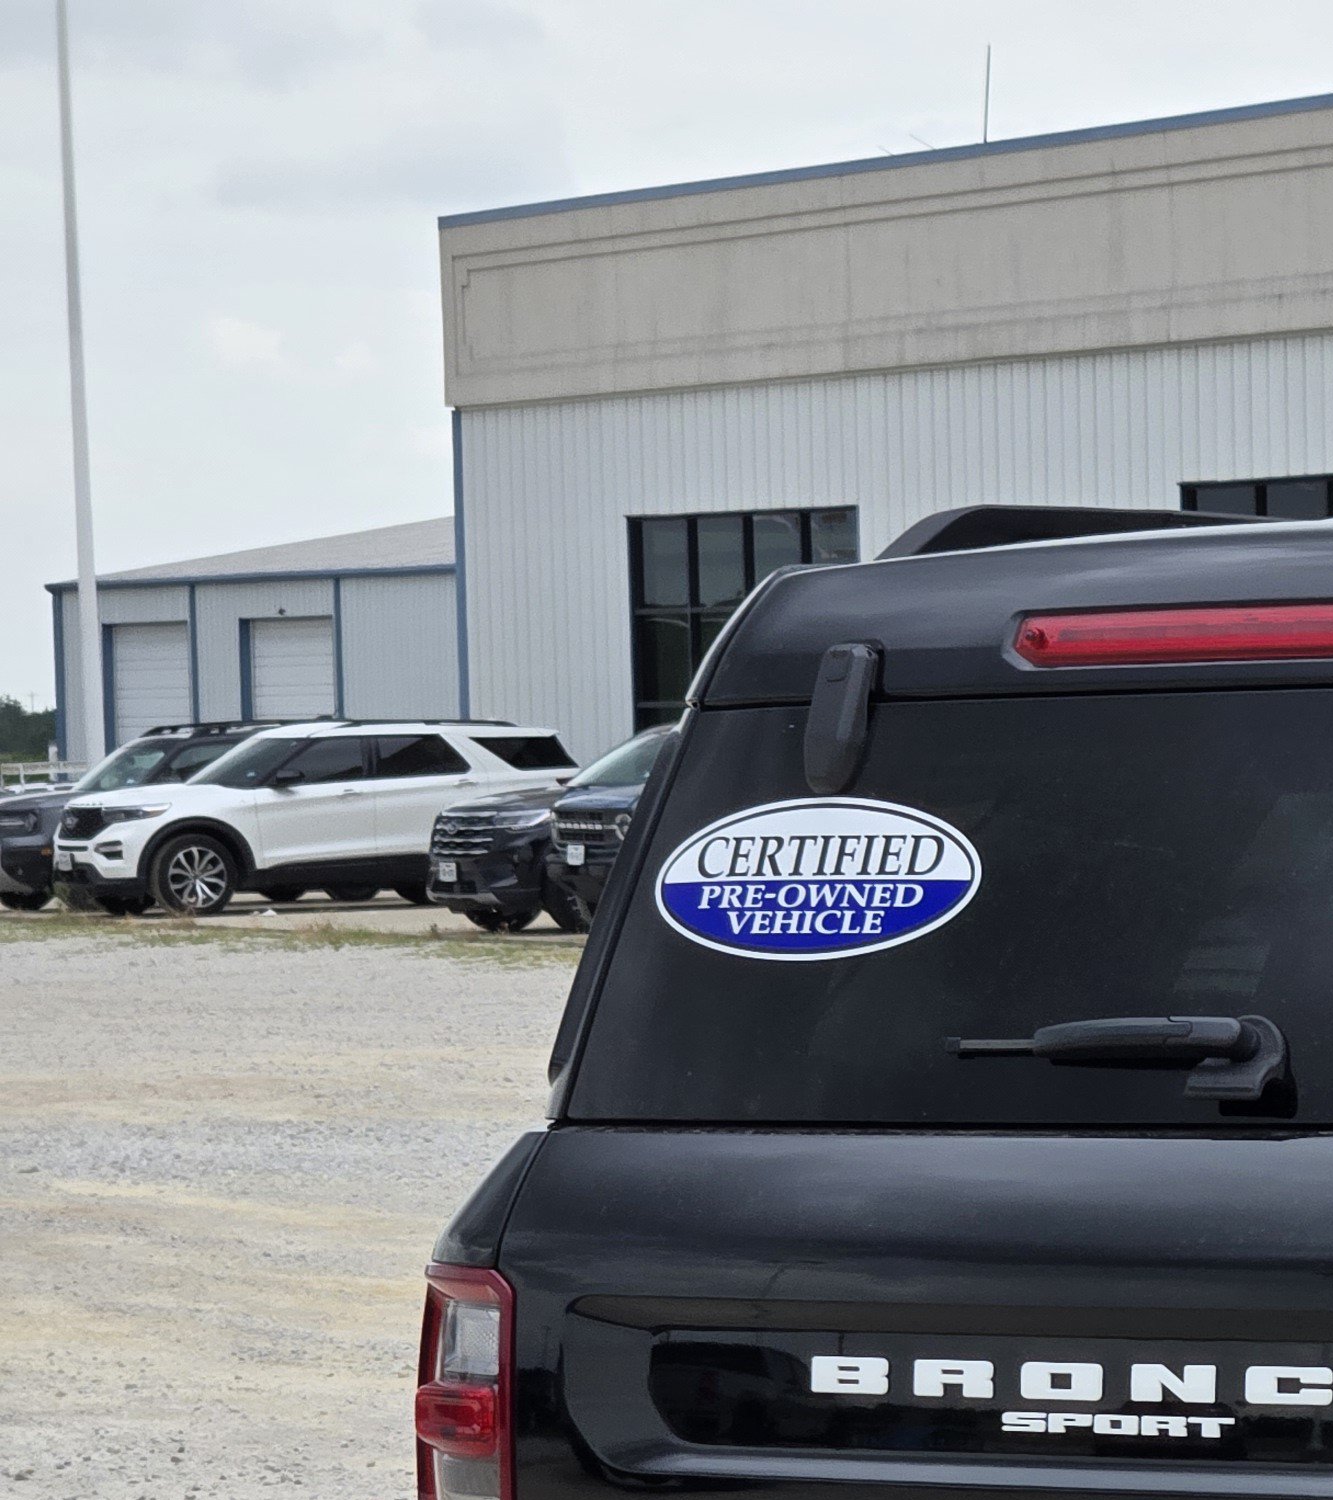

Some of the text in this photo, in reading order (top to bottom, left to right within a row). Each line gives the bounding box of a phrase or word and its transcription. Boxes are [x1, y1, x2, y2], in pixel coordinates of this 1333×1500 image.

[697, 834, 945, 878] CERTIFIED
[698, 884, 923, 909] PRE-OWNED
[729, 910, 885, 935] VEHICLE
[1001, 1411, 1235, 1439] SPORT
